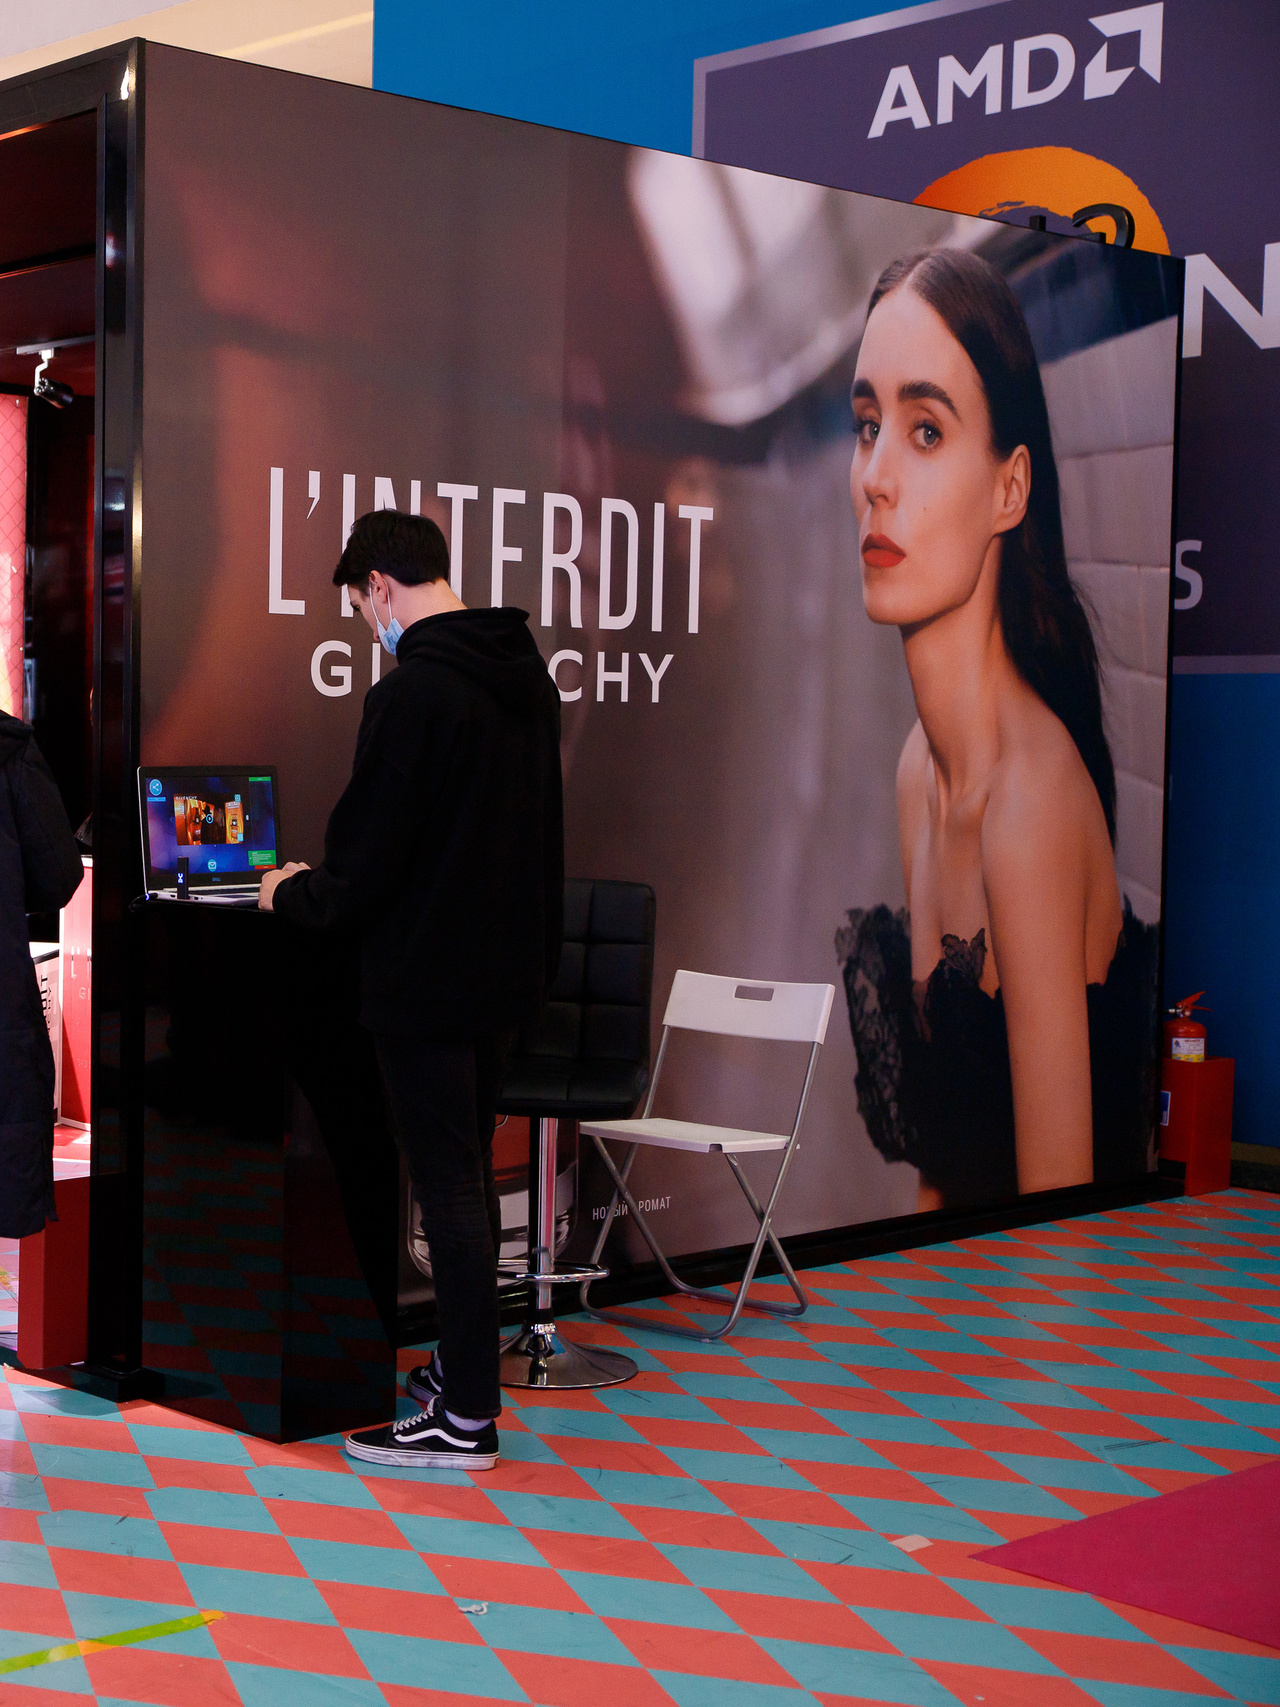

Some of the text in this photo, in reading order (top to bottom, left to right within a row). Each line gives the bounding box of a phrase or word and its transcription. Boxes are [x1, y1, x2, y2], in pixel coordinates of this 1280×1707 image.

[867, 32, 1076, 139] AMD
[269, 467, 714, 634] L'ITERDIT
[310, 640, 675, 703] GICHY
[592, 1196, 672, 1220] НОЫЙ РОМАТ
